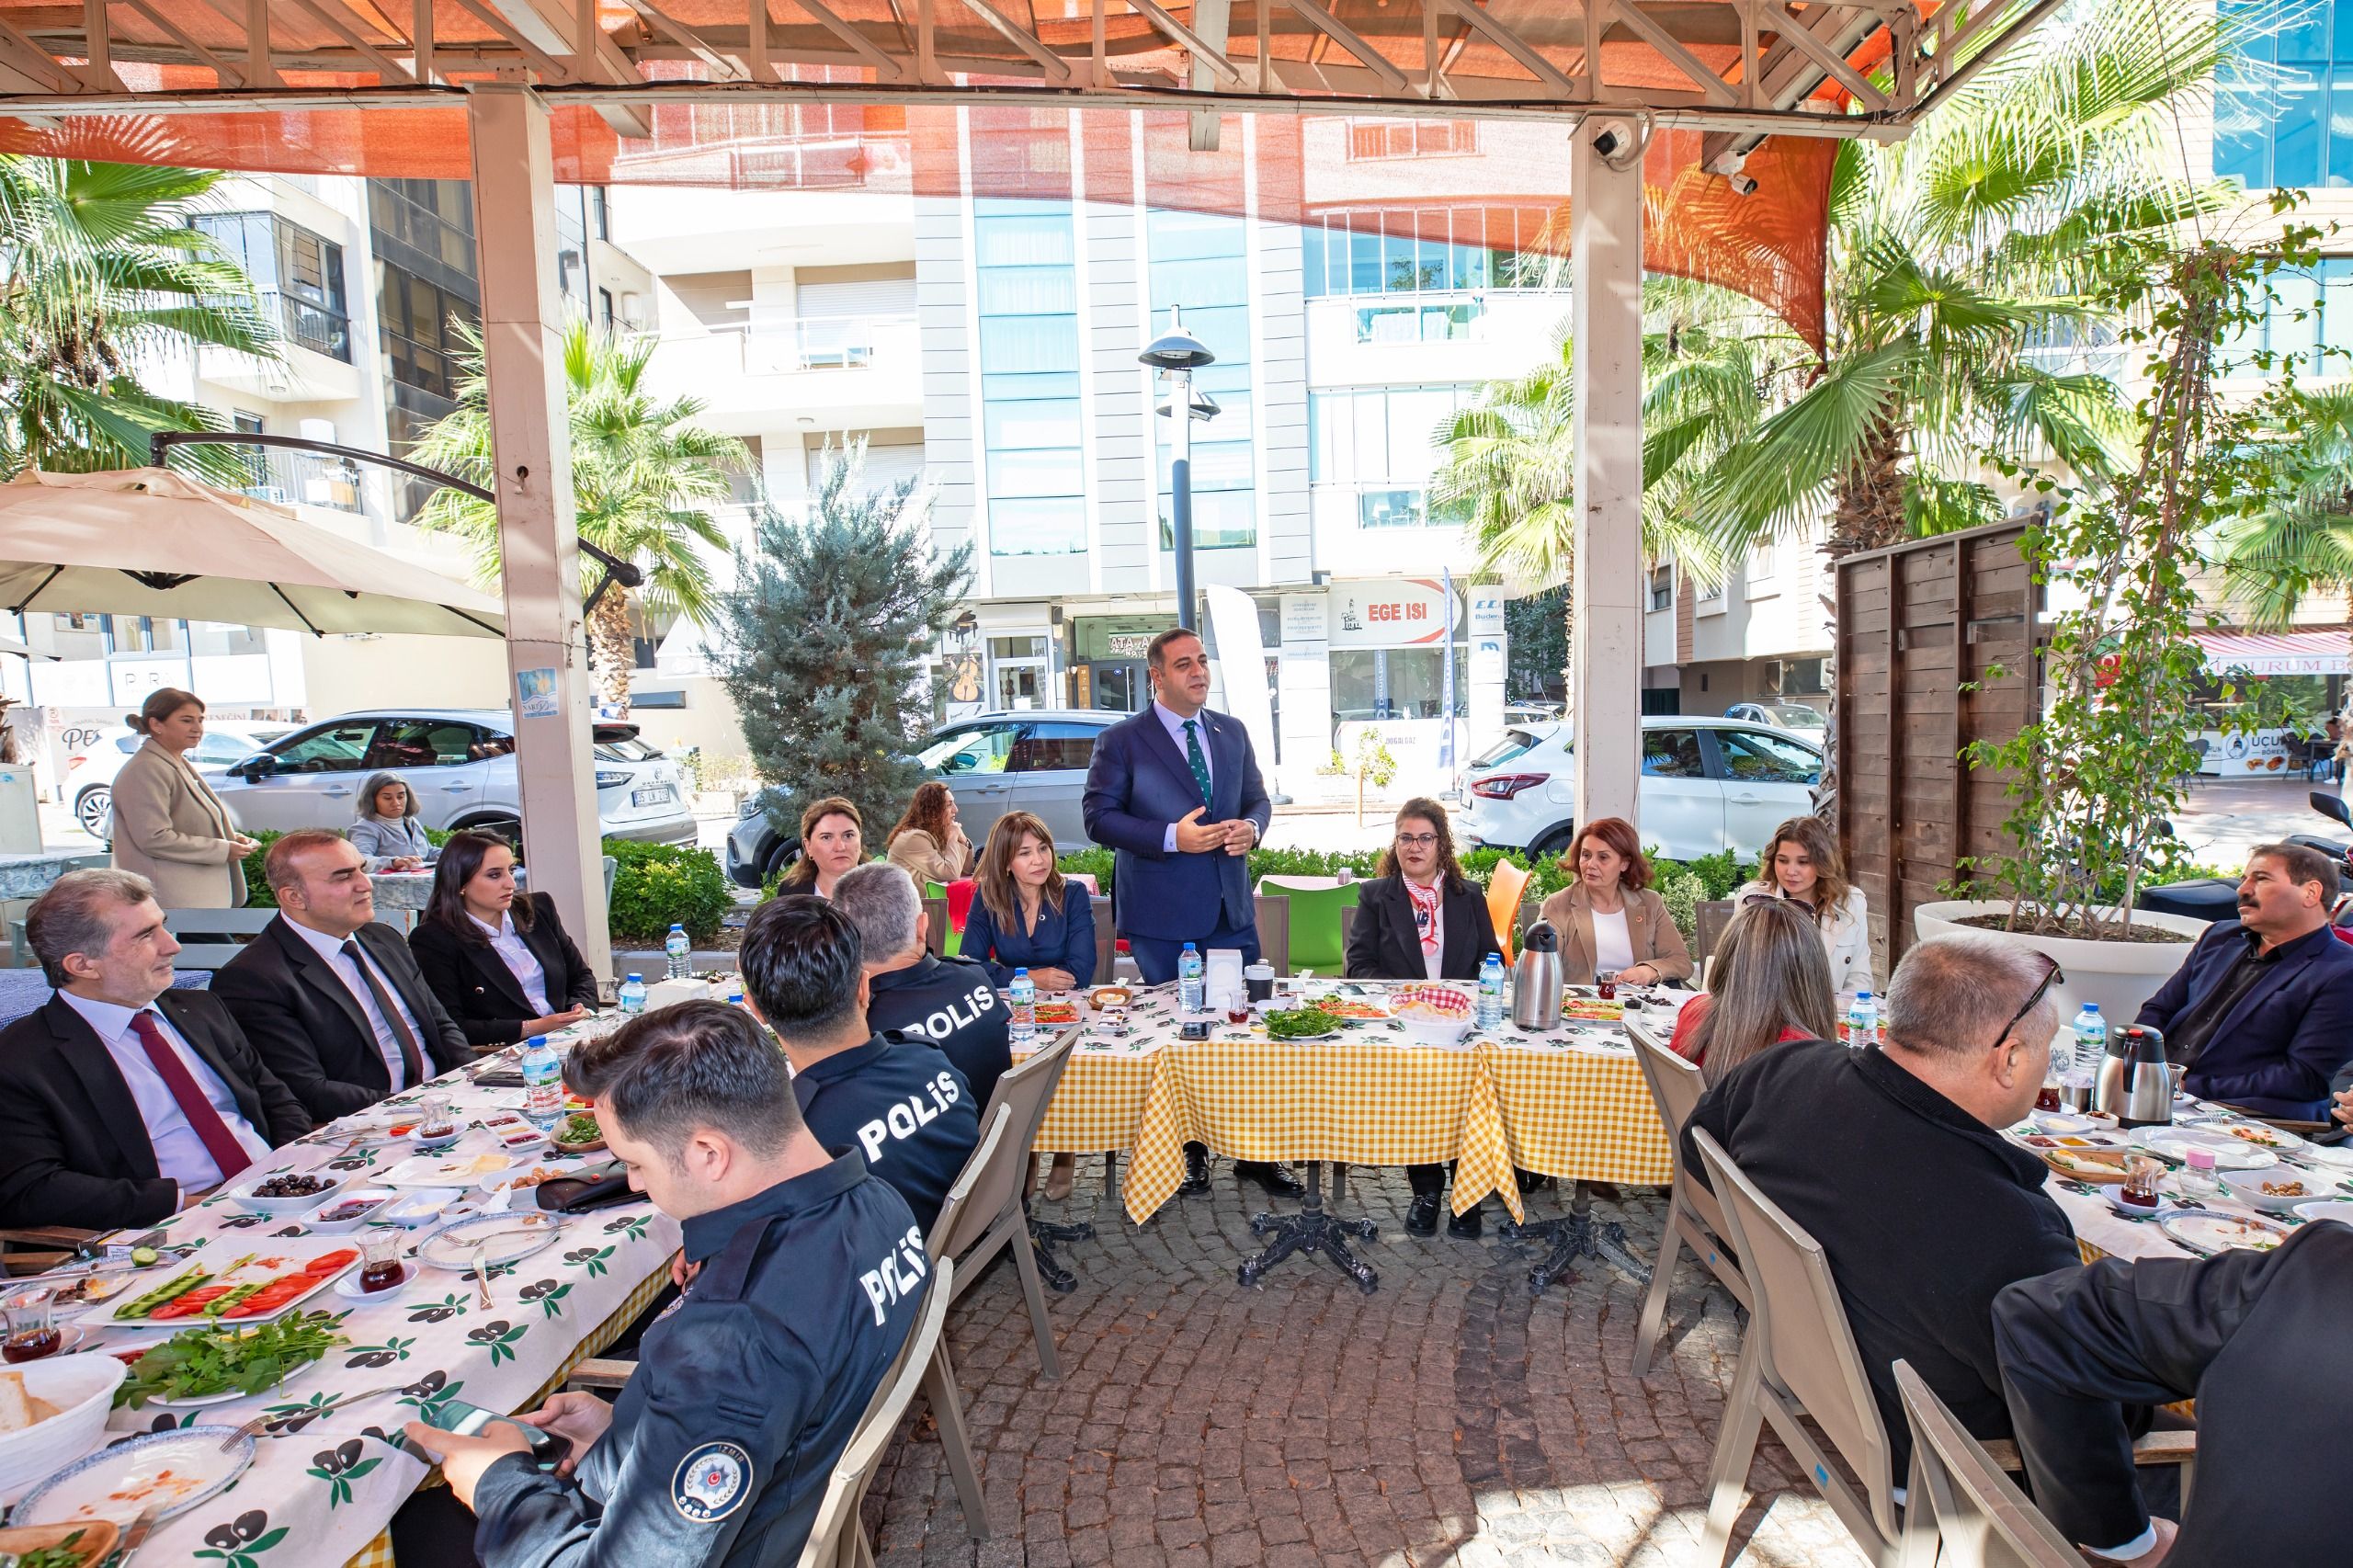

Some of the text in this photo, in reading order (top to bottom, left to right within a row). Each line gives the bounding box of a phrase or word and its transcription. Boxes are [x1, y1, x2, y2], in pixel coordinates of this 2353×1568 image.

[1369, 602, 1427, 621] EGE ISI
[1110, 636, 1133, 649] ATA
